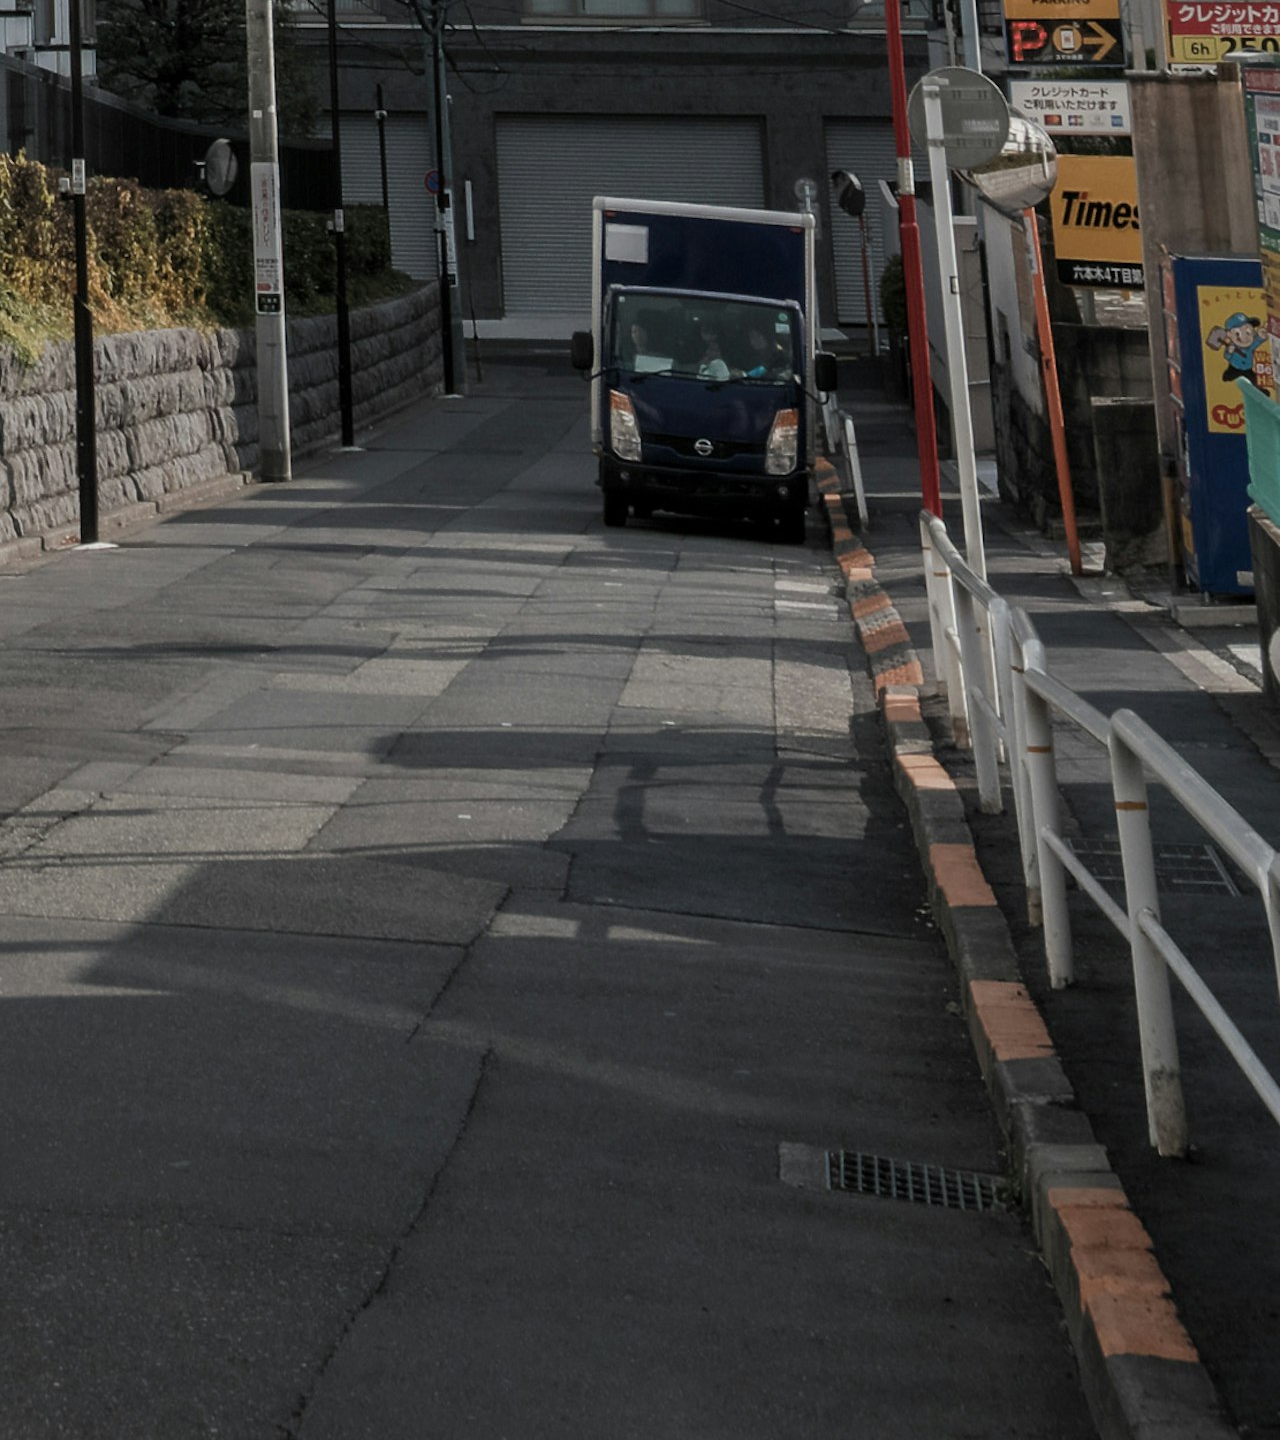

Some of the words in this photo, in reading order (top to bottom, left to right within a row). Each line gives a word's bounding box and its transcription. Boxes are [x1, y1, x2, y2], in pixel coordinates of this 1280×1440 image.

[1178, 5, 1279, 23] クレジットカ
[1191, 42, 1210, 56] 6h
[1031, 87, 1109, 98] クレジットカード
[1023, 99, 1118, 110] ご利用いただけます
